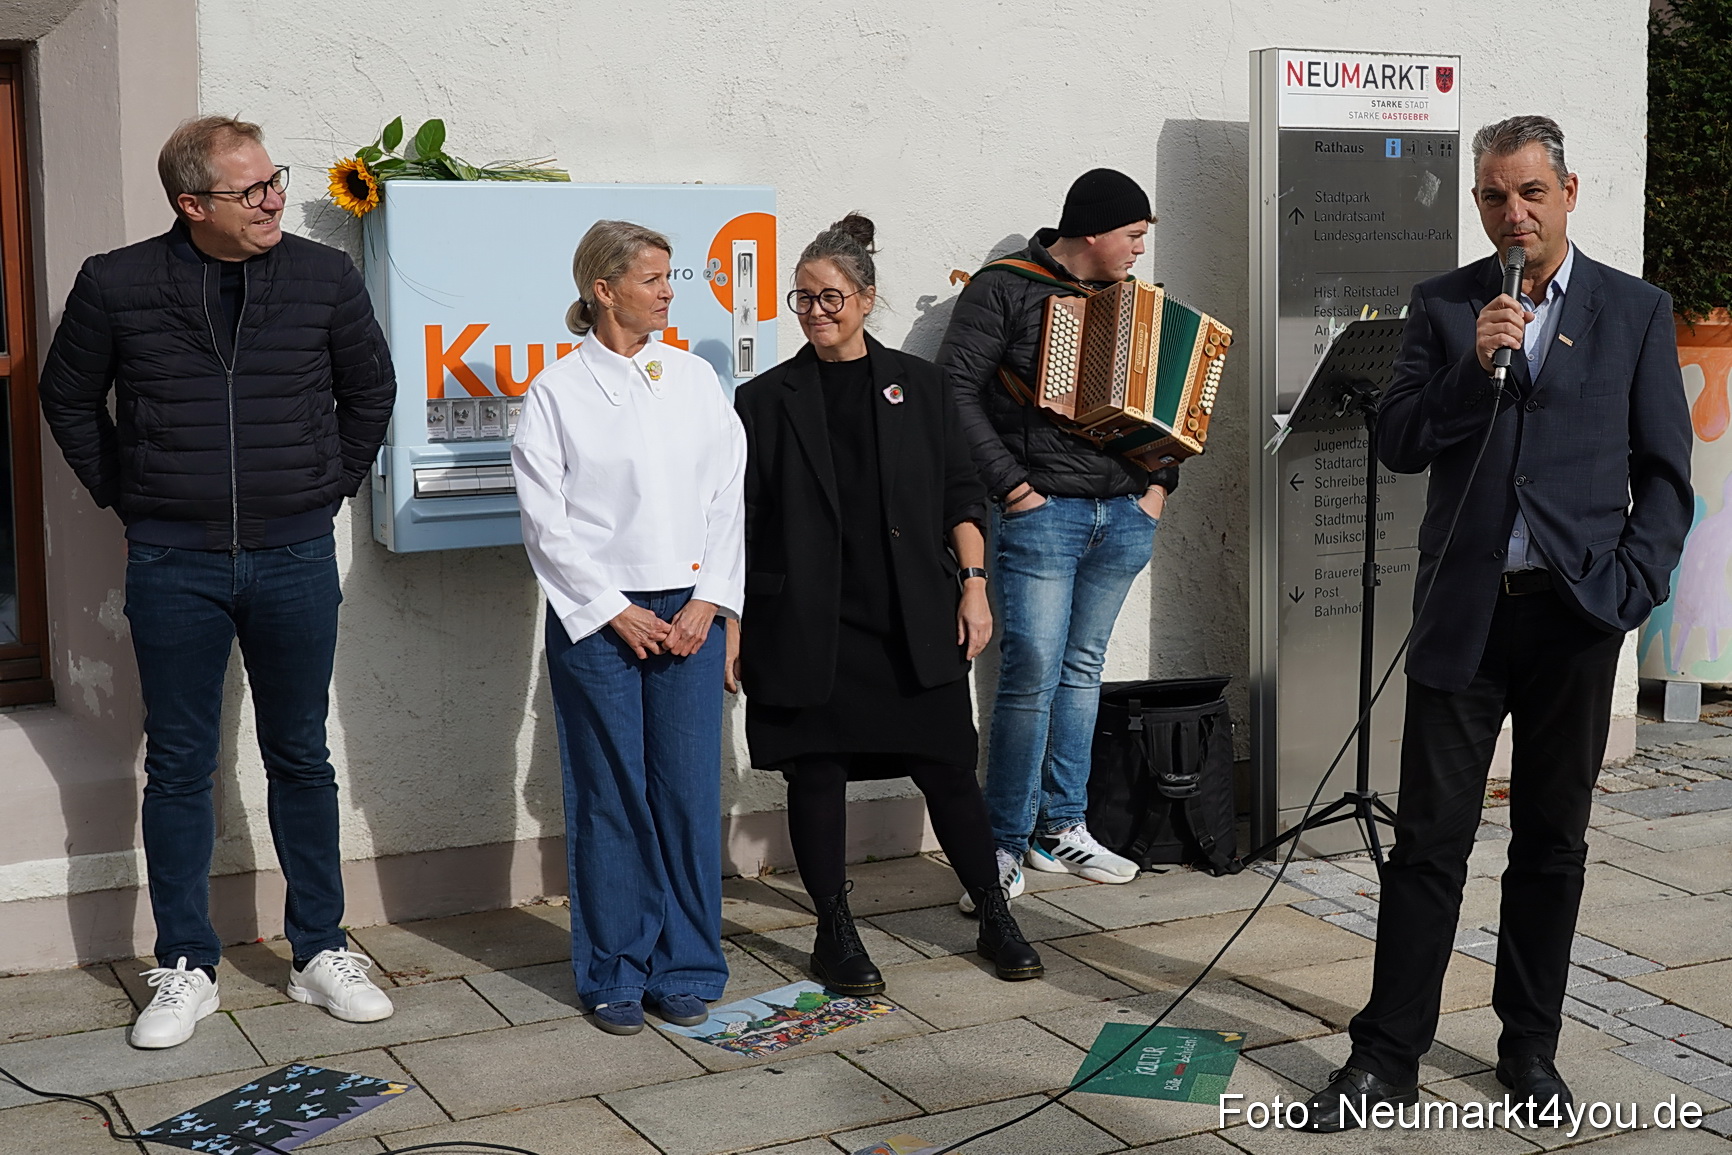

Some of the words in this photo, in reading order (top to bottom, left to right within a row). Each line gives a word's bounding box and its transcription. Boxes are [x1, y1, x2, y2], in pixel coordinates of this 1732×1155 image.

[1287, 60, 1430, 91] NEUMARKT
[1371, 100, 1403, 109] STARKE
[1404, 101, 1430, 110] STADT
[1348, 111, 1380, 120] STARKE
[1382, 112, 1430, 121] GASTGEBER
[1314, 140, 1366, 154] Rathaus
[1314, 190, 1371, 204] Stadtpark
[1314, 210, 1386, 223] Landratsamt
[1314, 228, 1454, 244] Landesgartenschau-Park
[1313, 286, 1341, 299] Hist.
[1343, 285, 1400, 298] Reitstadel
[1313, 304, 1360, 318] Festsäle
[1314, 436, 1370, 454] Jugendze
[1314, 492, 1381, 509] Bürgerhas
[1314, 528, 1387, 546] Musikschle
[1314, 586, 1340, 599] Post
[1314, 602, 1363, 618] Bahnhof
